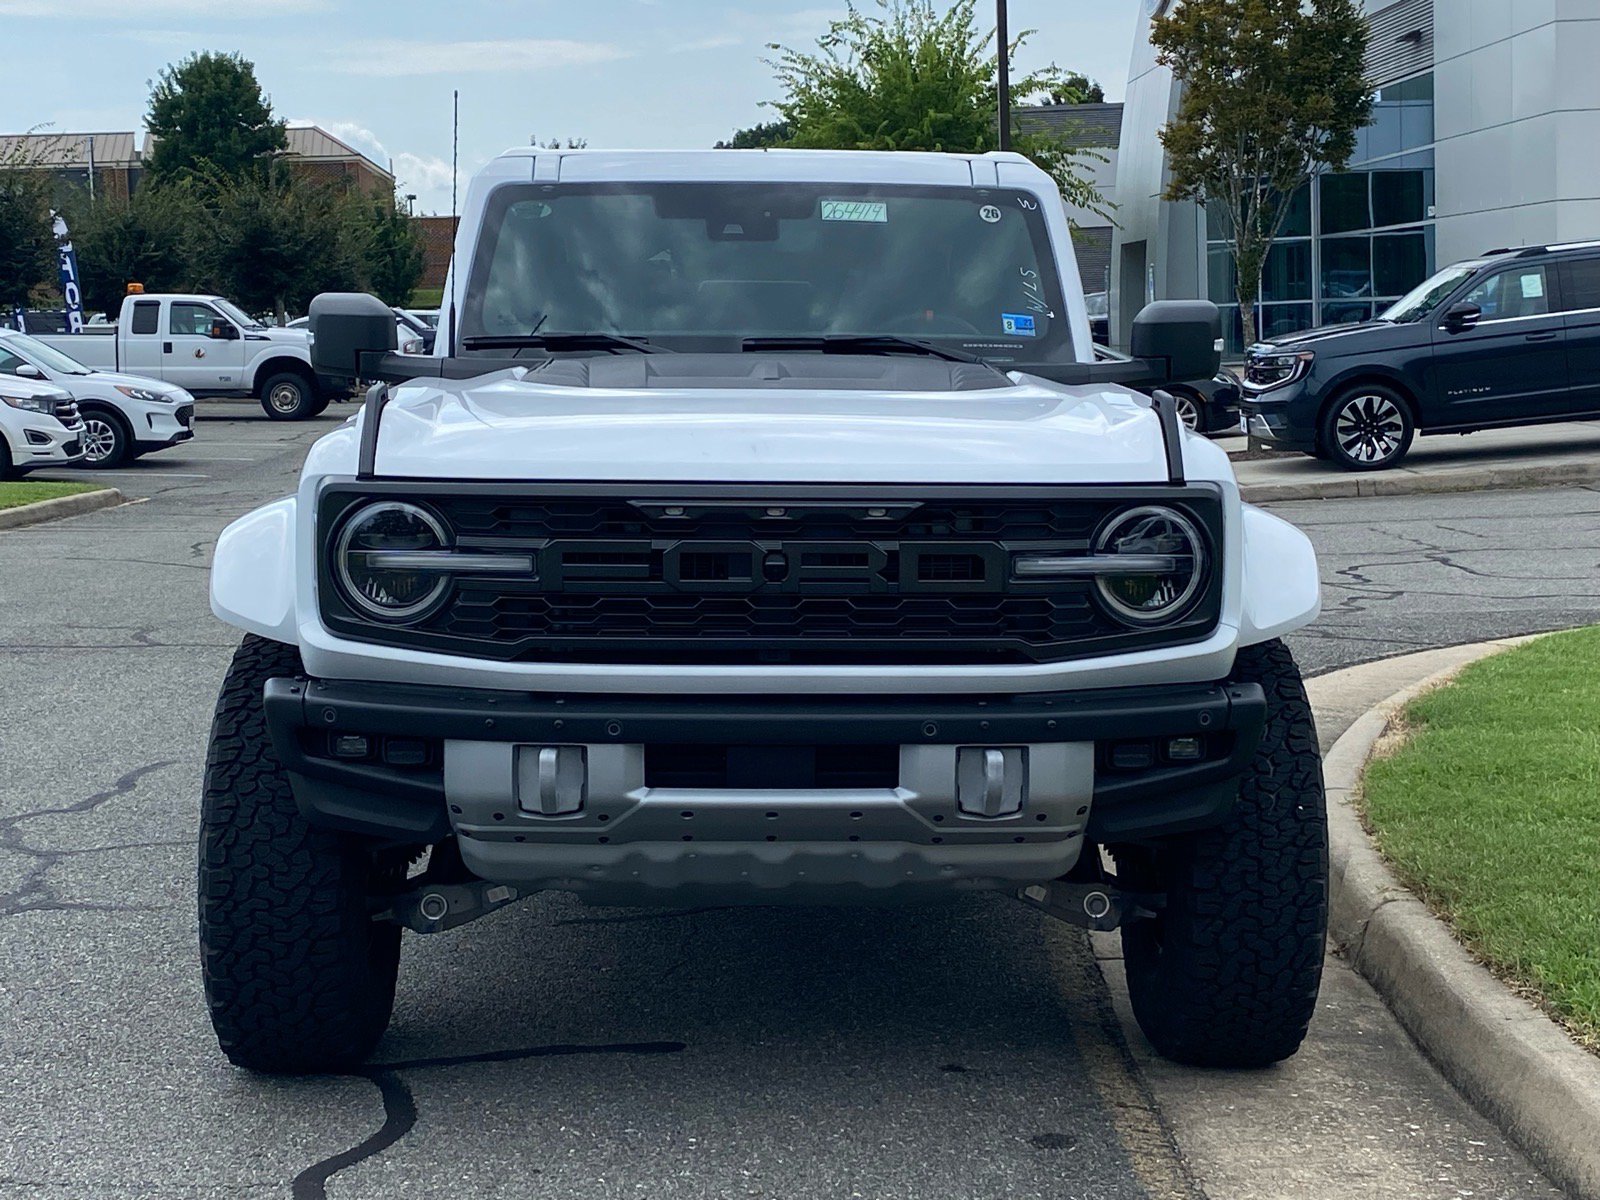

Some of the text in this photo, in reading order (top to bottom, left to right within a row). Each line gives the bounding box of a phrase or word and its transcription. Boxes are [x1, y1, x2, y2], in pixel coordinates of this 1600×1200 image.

[983, 207, 999, 219] 26
[1006, 320, 1013, 330] 8
[539, 539, 1007, 593] FORD
